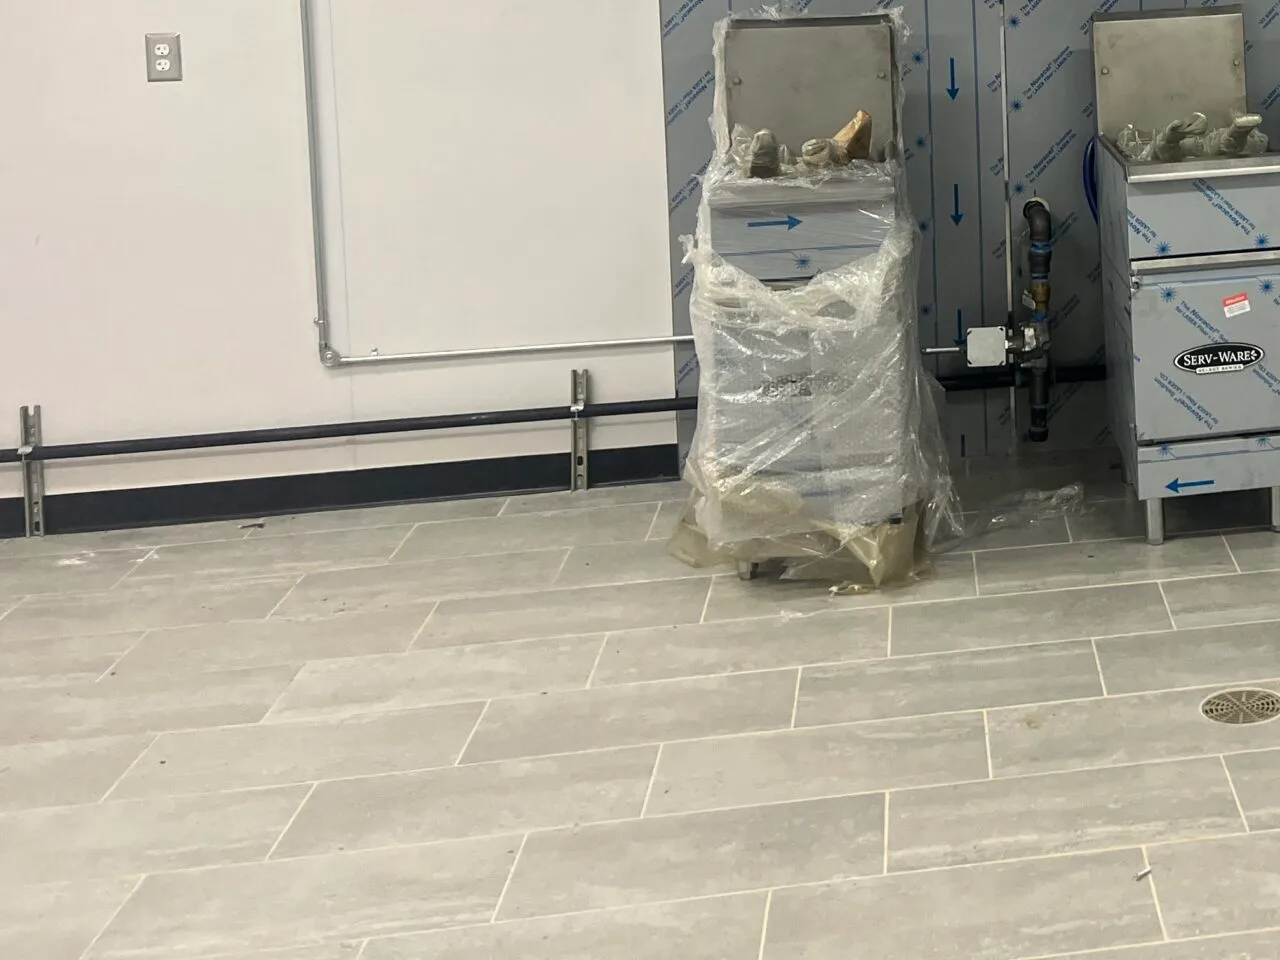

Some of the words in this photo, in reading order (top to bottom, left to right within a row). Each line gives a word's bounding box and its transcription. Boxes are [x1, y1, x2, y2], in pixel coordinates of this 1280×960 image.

[1234, 210, 1248, 223] LASER
[1136, 218, 1149, 231] LASER
[1183, 313, 1196, 325] LASER
[1183, 350, 1251, 366] SERV-WARE
[1168, 380, 1182, 393] LASER
[1197, 405, 1211, 417] LASER
